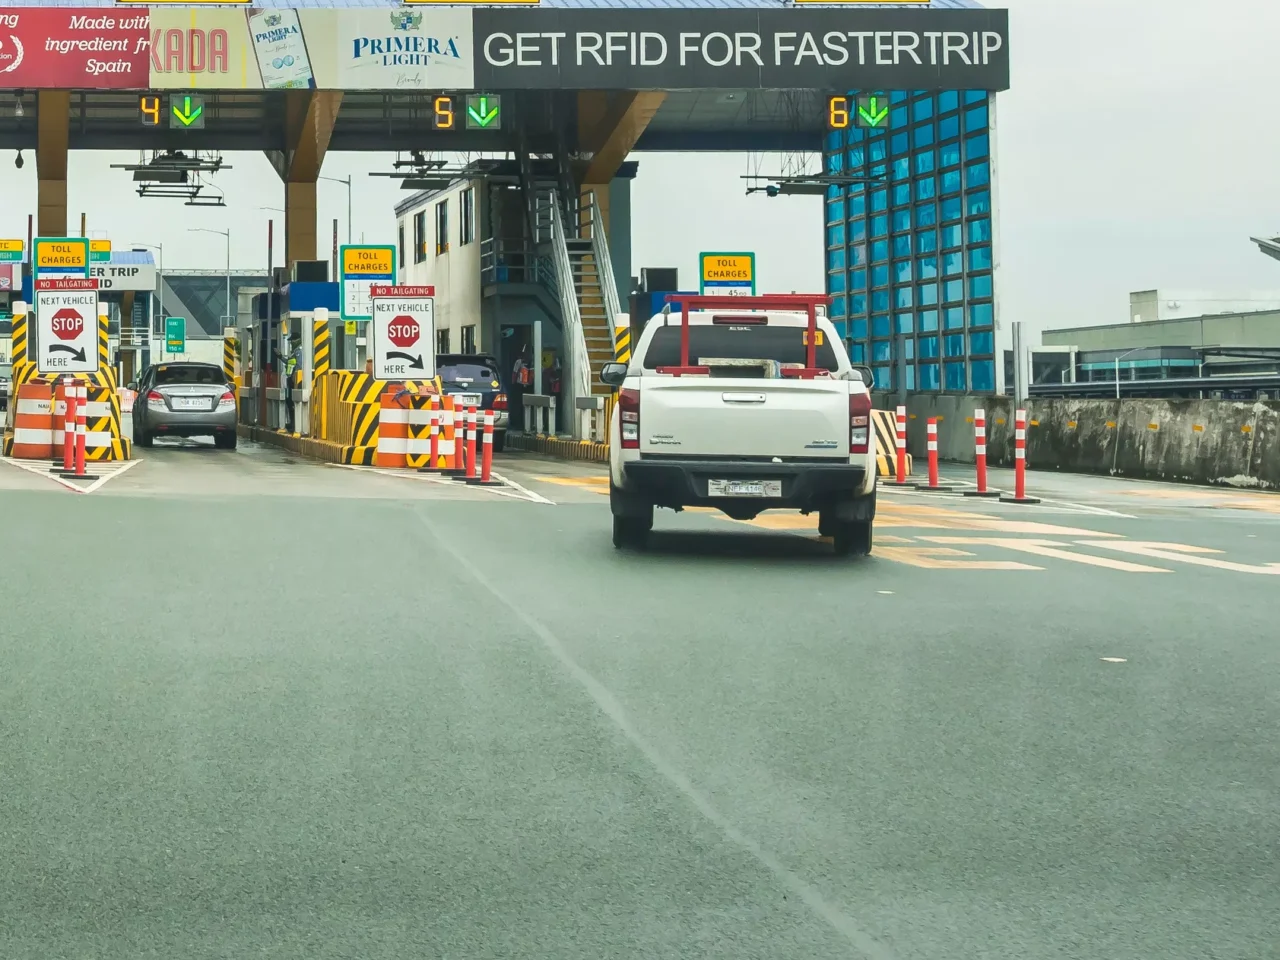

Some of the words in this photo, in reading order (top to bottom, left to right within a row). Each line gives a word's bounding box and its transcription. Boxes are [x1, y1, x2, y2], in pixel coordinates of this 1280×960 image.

[69, 15, 115, 30] Made
[255, 25, 299, 43] PRIMERA
[45, 37, 128, 54] ingredient
[133, 37, 150, 55] fr
[352, 36, 461, 59] PRIMERA
[483, 32, 566, 66] GET
[576, 32, 667, 66] RFID
[680, 32, 765, 66] FOR
[383, 54, 431, 66] LIGHT
[85, 59, 132, 76] Spain
[141, 96, 160, 125] 4
[435, 97, 453, 128] 5
[829, 96, 848, 128] 6
[51, 245, 72, 253] TOLL
[41, 256, 82, 264] CHARGES
[358, 252, 378, 260] TOLL
[348, 263, 388, 271] CHARGES
[717, 259, 737, 267] TOLL
[109, 267, 140, 277] TRIP
[707, 270, 748, 278] CHARGES
[40, 280, 51, 288] NO
[55, 280, 93, 288] TAILGATING
[376, 287, 387, 295] NO
[390, 287, 429, 295] TAILGATING
[40, 297, 60, 305] NEXT
[61, 296, 94, 305] VEHICLE
[376, 303, 395, 312] NEXT
[397, 303, 430, 312] VEHICLE
[52, 317, 83, 331] STOP
[388, 324, 420, 339] STOP
[46, 357, 68, 367] HERE
[383, 365, 406, 374] HERE
